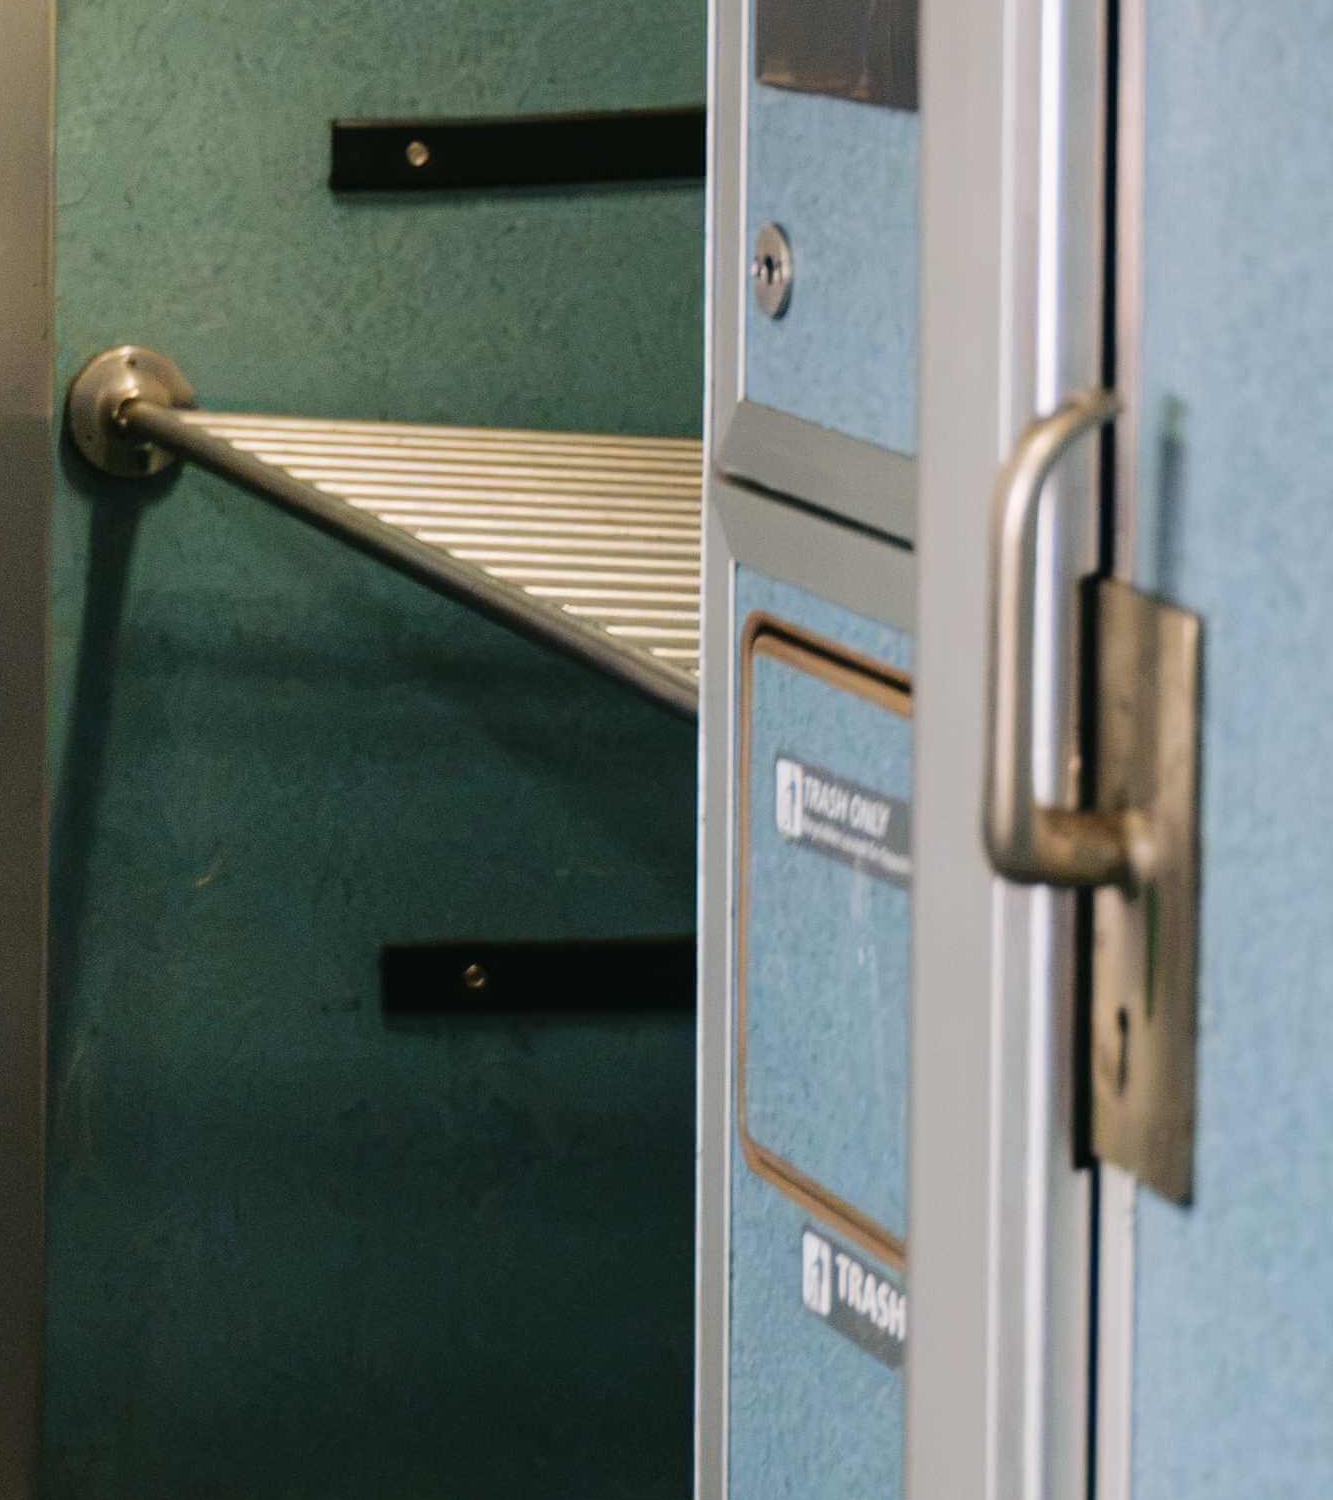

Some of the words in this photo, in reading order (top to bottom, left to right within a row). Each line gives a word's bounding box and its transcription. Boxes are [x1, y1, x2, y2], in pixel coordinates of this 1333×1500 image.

[804, 775, 850, 822] TRASH
[850, 793, 891, 839] ONLY
[835, 1253, 907, 1342] TRASH
